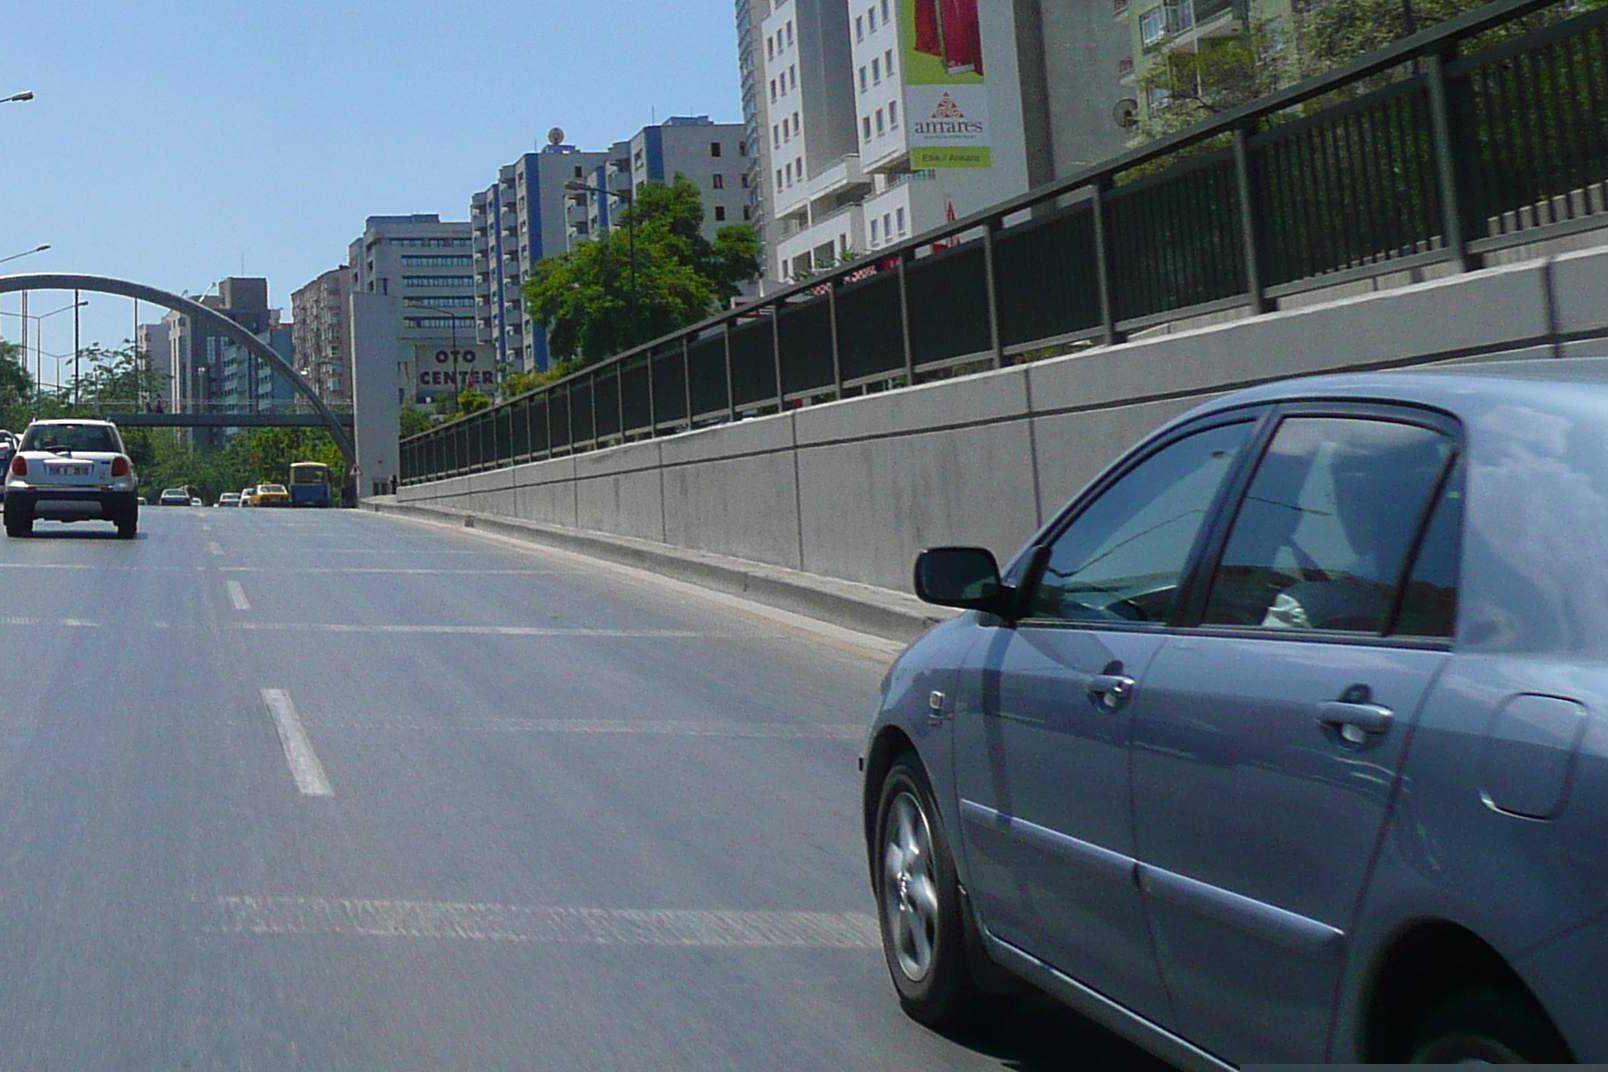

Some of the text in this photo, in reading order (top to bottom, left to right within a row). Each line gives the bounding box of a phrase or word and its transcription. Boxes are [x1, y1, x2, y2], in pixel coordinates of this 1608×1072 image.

[914, 120, 983, 134] antares
[435, 349, 476, 364] OTO
[419, 370, 494, 385] CENTER
